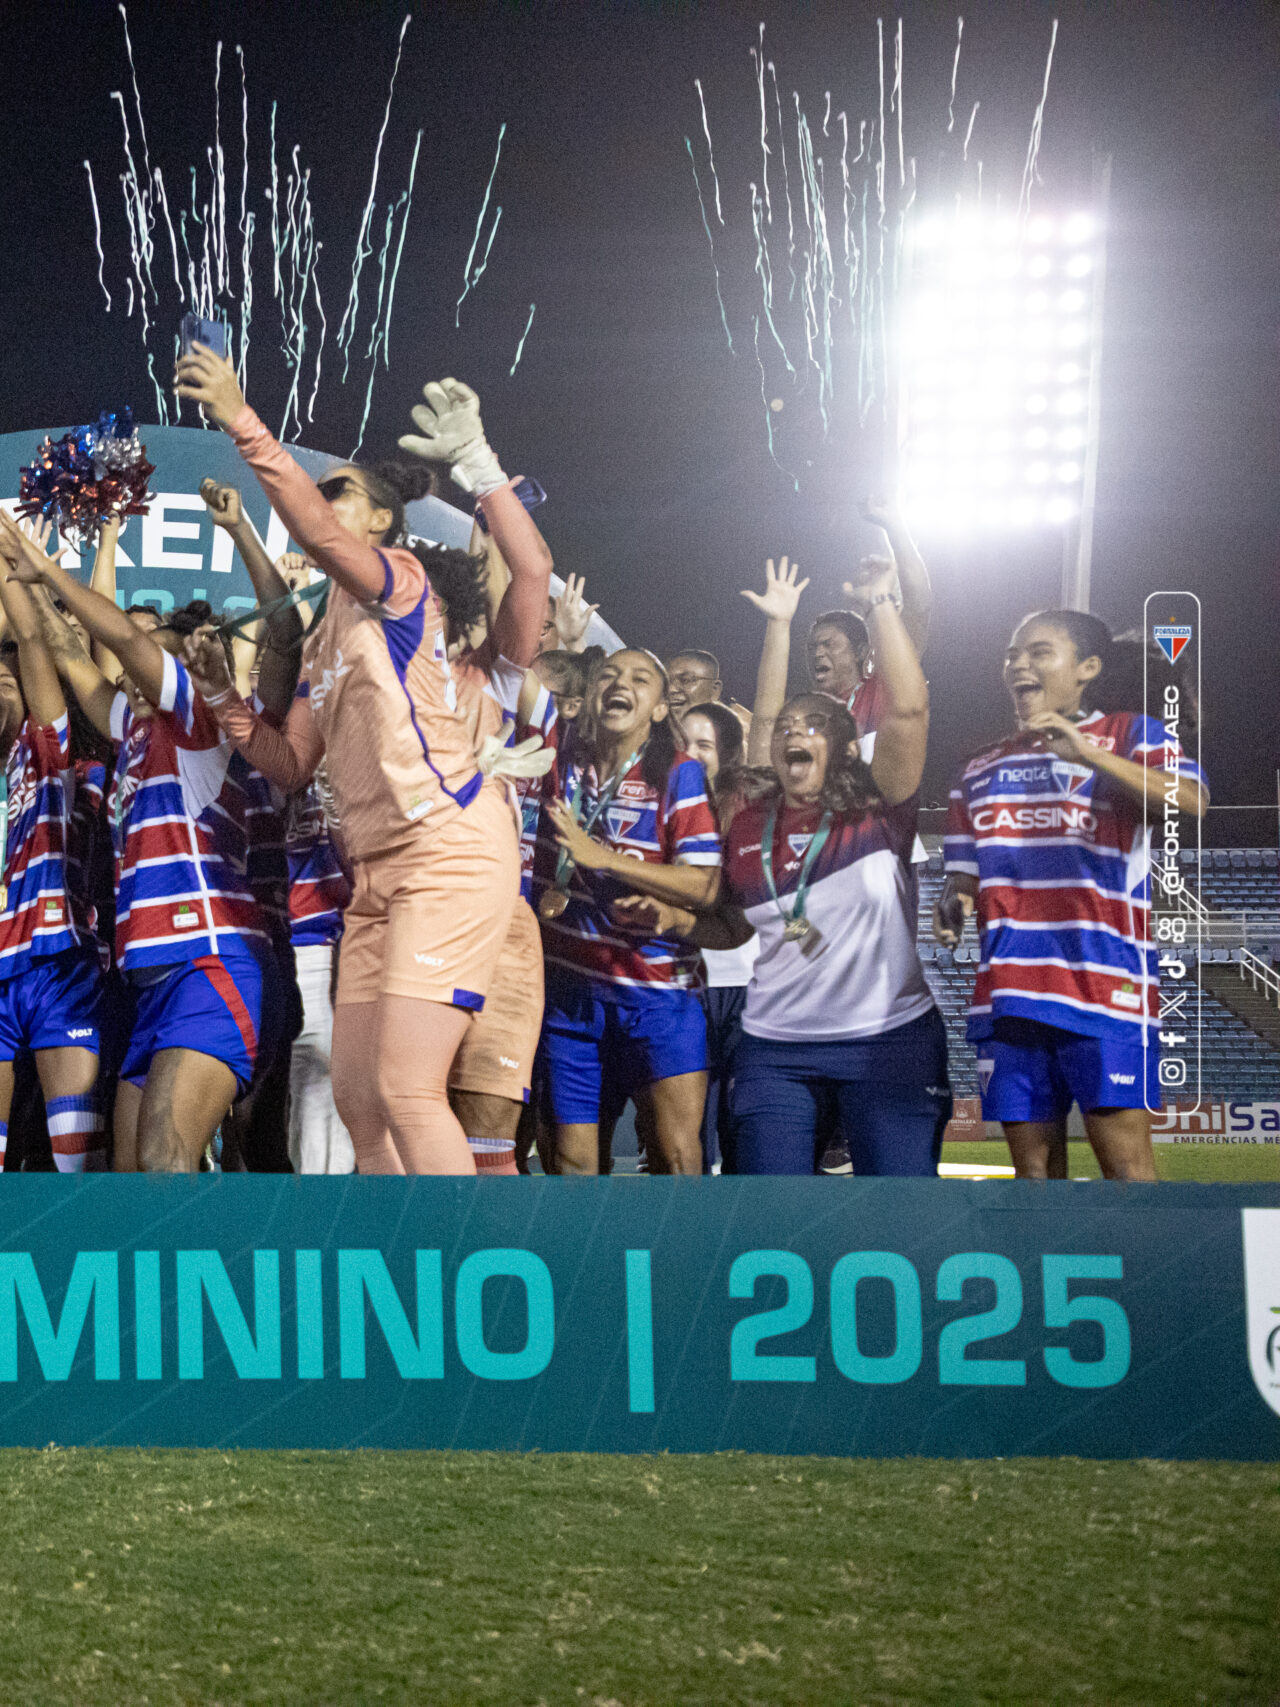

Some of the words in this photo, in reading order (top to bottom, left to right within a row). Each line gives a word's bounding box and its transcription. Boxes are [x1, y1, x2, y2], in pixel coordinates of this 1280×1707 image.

[973, 807, 1099, 831] CASSINO
[414, 953, 445, 967] VOLT
[67, 1028, 93, 1040] VOLT
[1109, 1073, 1136, 1085] VOLT
[1174, 1134, 1257, 1144] EMERGÊNCIAS
[728, 1249, 1131, 1388] 2025
